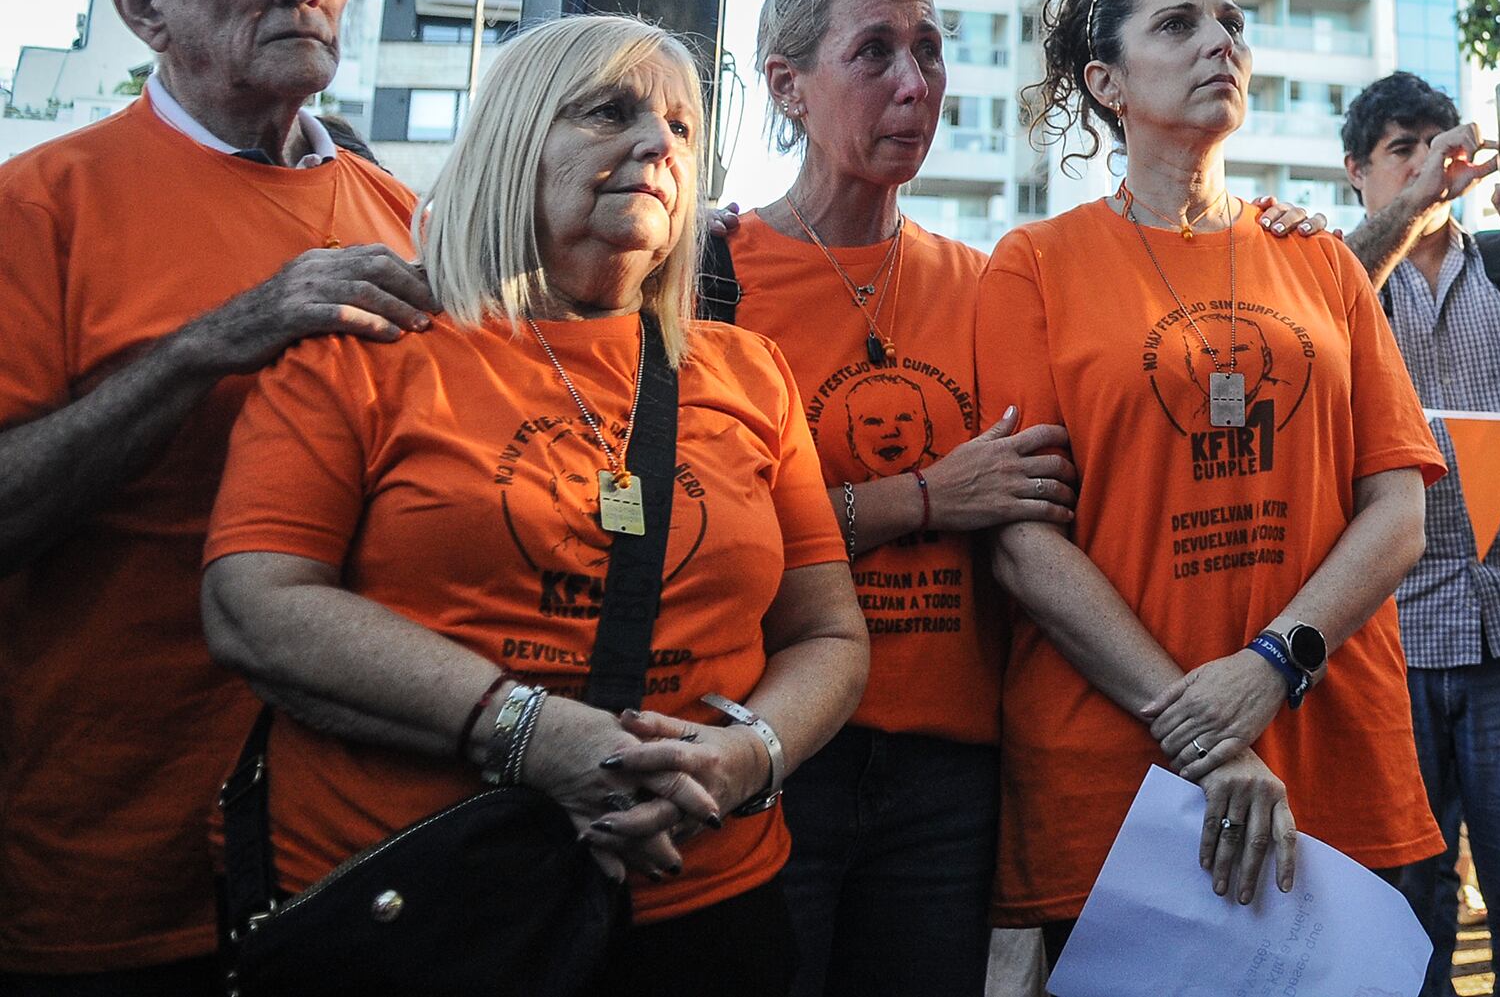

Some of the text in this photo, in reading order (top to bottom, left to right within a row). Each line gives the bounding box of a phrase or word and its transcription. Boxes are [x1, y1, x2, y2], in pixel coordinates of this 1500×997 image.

[1209, 300, 1233, 310] SIN
[1144, 329, 1162, 350] HAY
[1143, 352, 1158, 372] NO
[819, 361, 871, 398] FESTEJO
[1191, 428, 1257, 463] KFIR
[1193, 457, 1258, 482] CUMPLE
[1171, 503, 1253, 533] DEVUELVAN
[1173, 529, 1248, 556] DEVUELVAN
[1174, 548, 1285, 580] LOS SECUESADOS
[853, 568, 962, 589] UELVAN A KFIR
[910, 596, 919, 610] A
[922, 593, 961, 610] TODOS
[865, 617, 961, 634] ECUESTRADOS
[502, 637, 590, 667] DEVUEL
